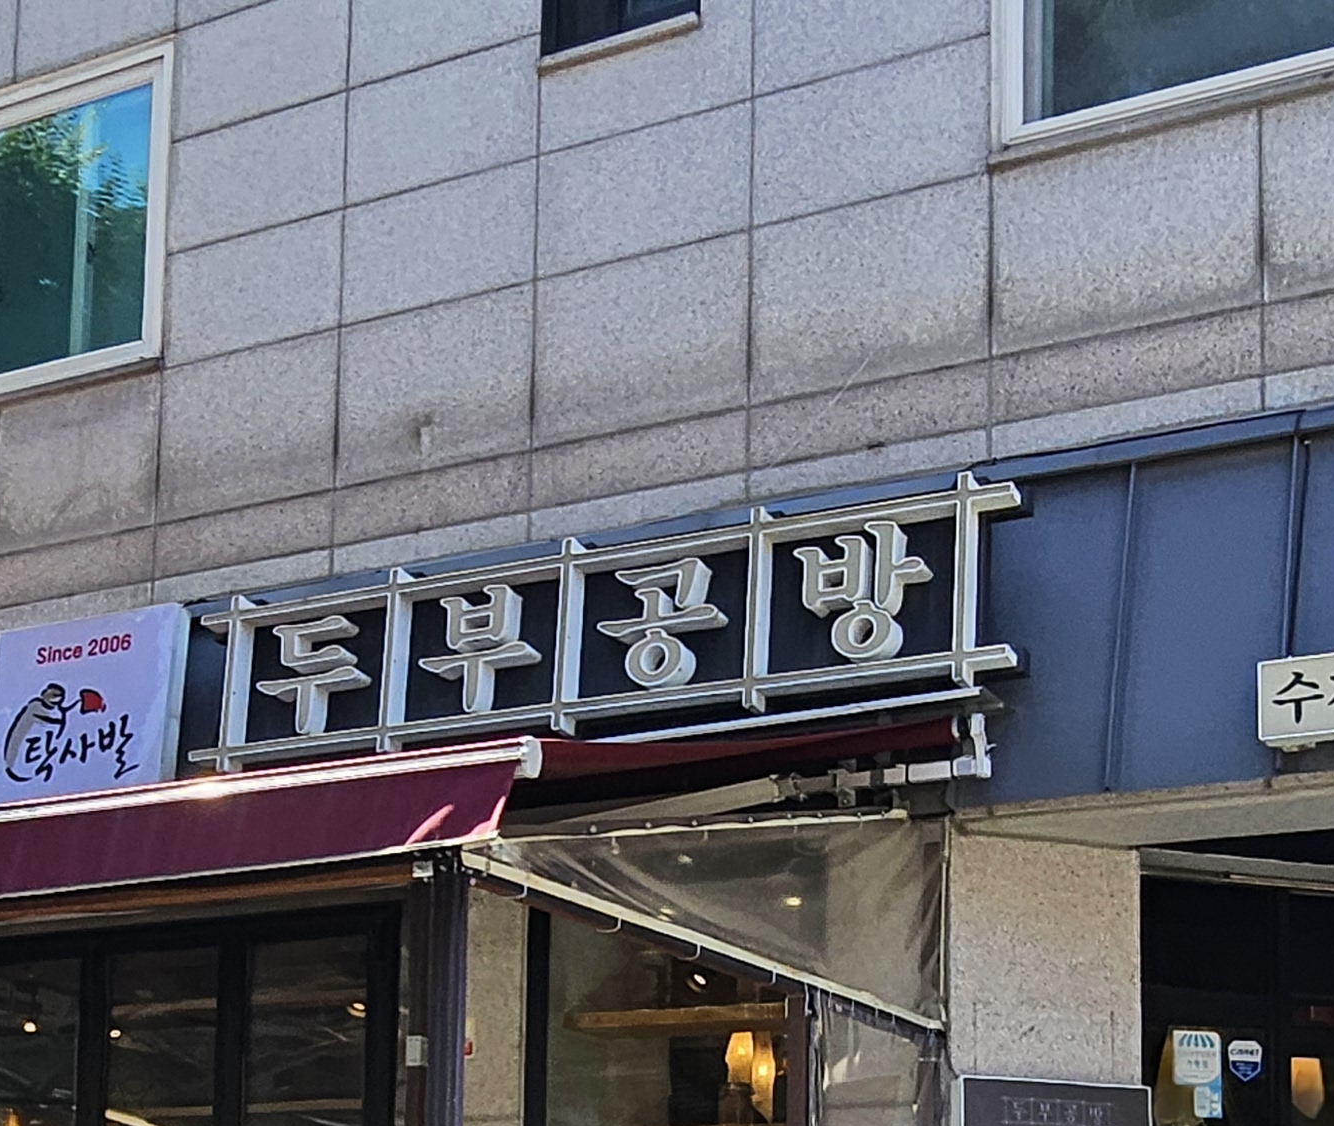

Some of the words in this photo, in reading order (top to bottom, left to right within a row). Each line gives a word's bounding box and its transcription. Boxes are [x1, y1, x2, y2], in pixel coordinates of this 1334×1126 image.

[36, 644, 83, 664] Since
[88, 633, 132, 656] 2006
[257, 521, 933, 735] 두부공방
[25, 714, 140, 782] 탁사발
